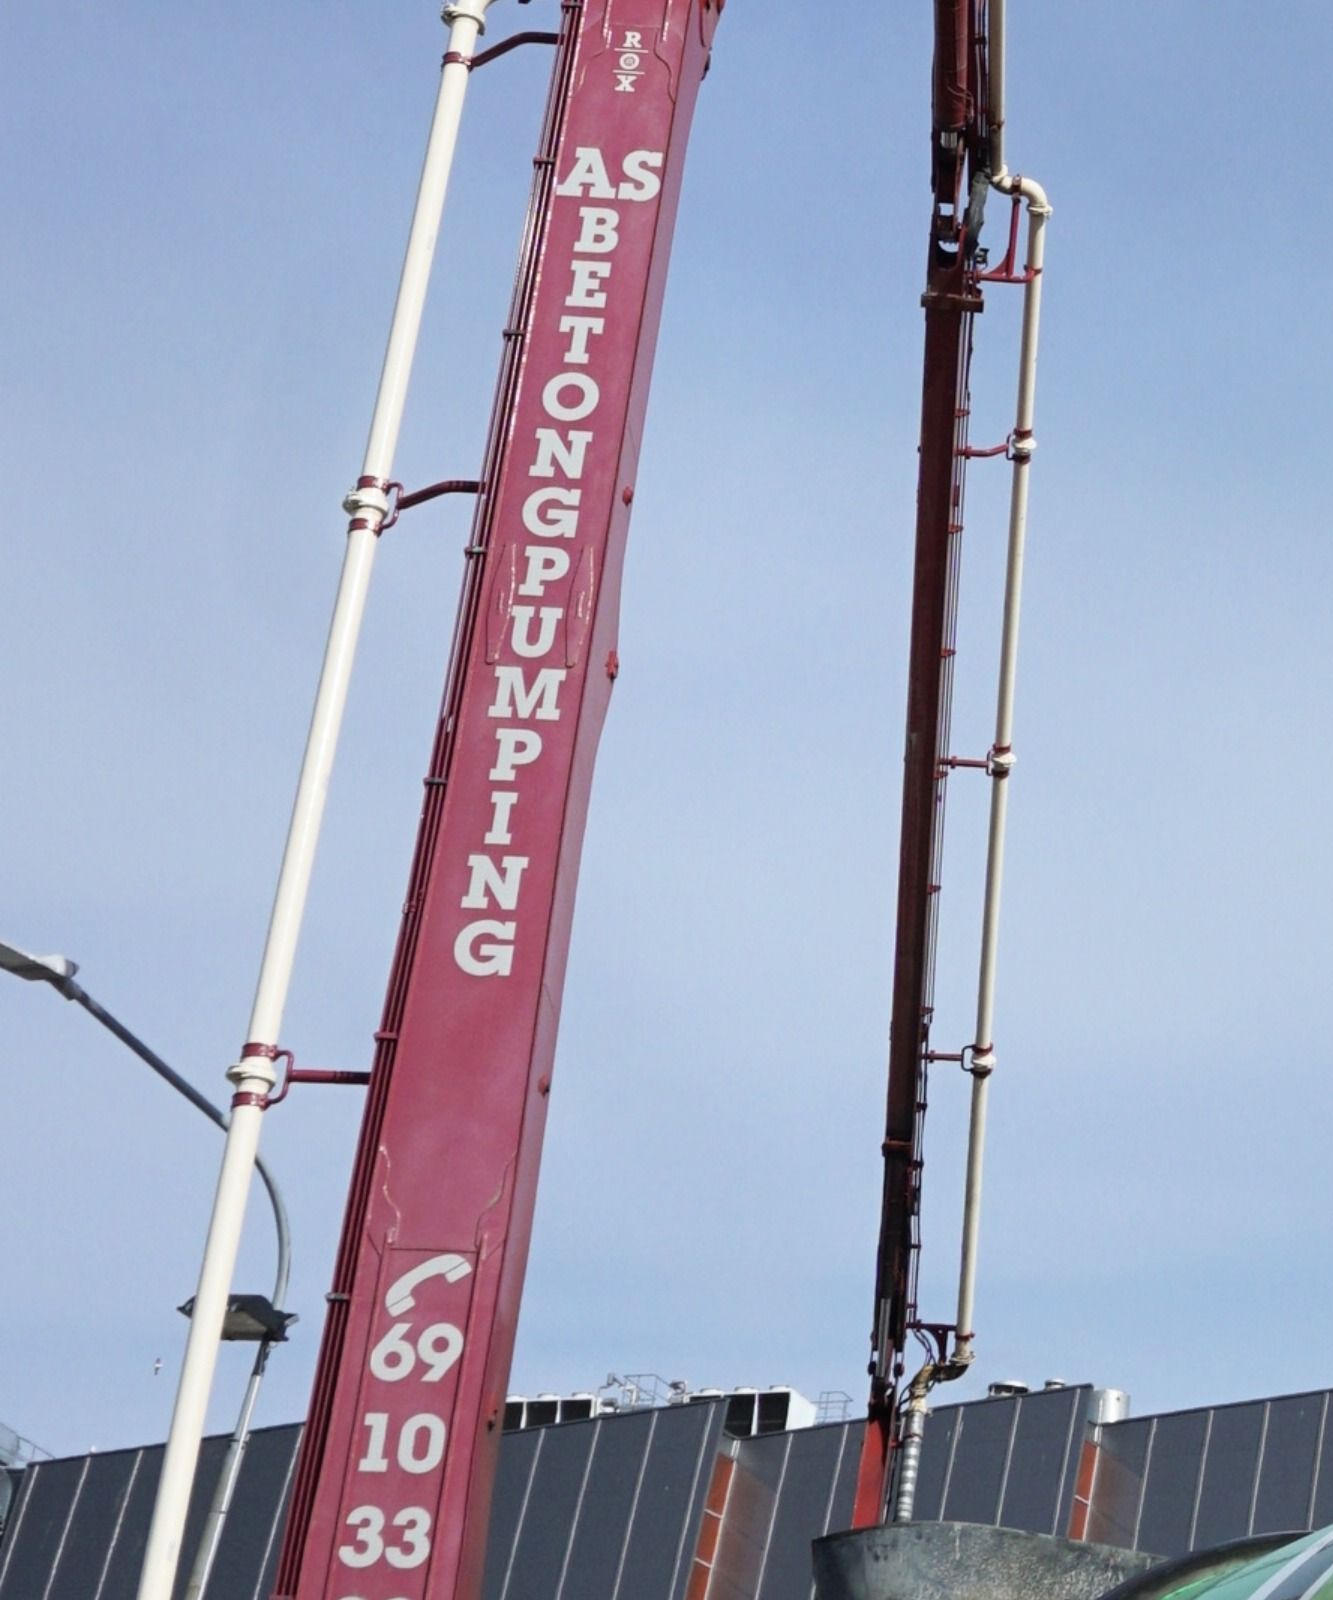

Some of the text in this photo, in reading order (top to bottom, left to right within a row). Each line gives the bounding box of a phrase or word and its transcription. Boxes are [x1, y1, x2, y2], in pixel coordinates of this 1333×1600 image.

[454, 147, 664, 976] AS BETONGPUMPING
[370, 1323, 464, 1382] 69
[358, 1413, 446, 1474] 10
[338, 1505, 431, 1569] 33
